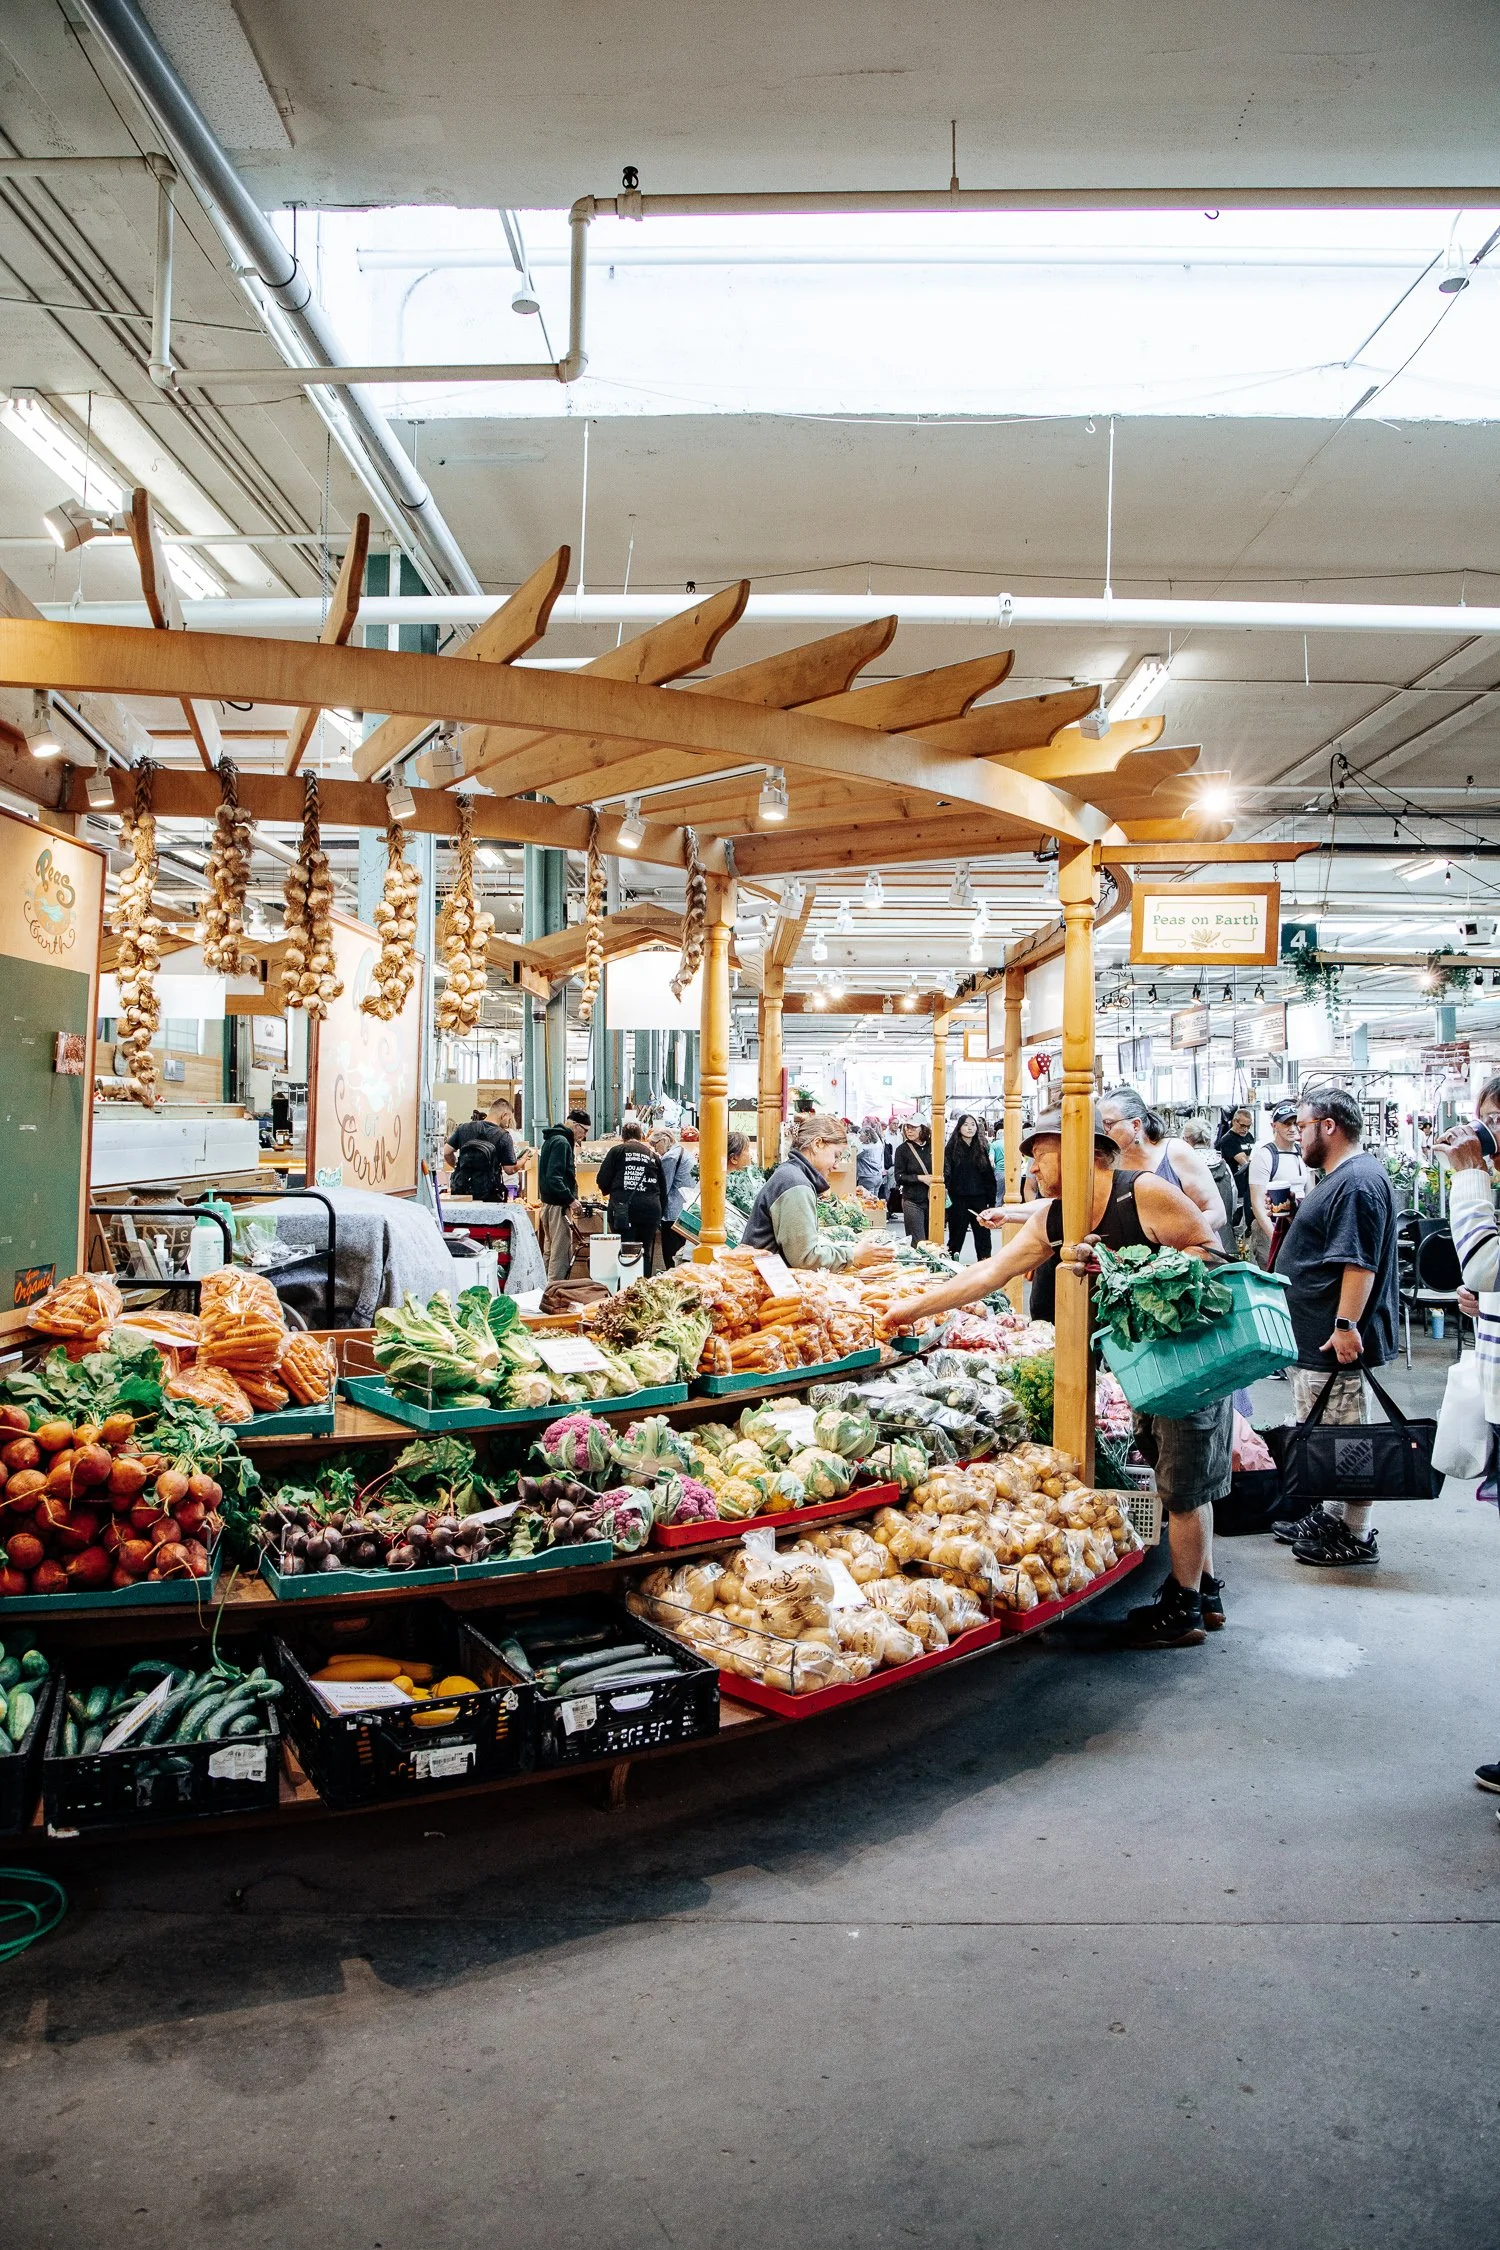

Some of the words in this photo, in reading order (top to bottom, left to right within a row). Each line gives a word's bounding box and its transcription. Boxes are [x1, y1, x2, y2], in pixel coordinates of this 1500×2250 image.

[1153, 915, 1186, 925] Peas
[1191, 917, 1209, 925] on
[1215, 914, 1259, 925] Earth
[1290, 930, 1308, 949] 4
[335, 1074, 402, 1186] Earth
[1336, 1439, 1372, 1475] HOME
[1340, 1443, 1353, 1456] THE
